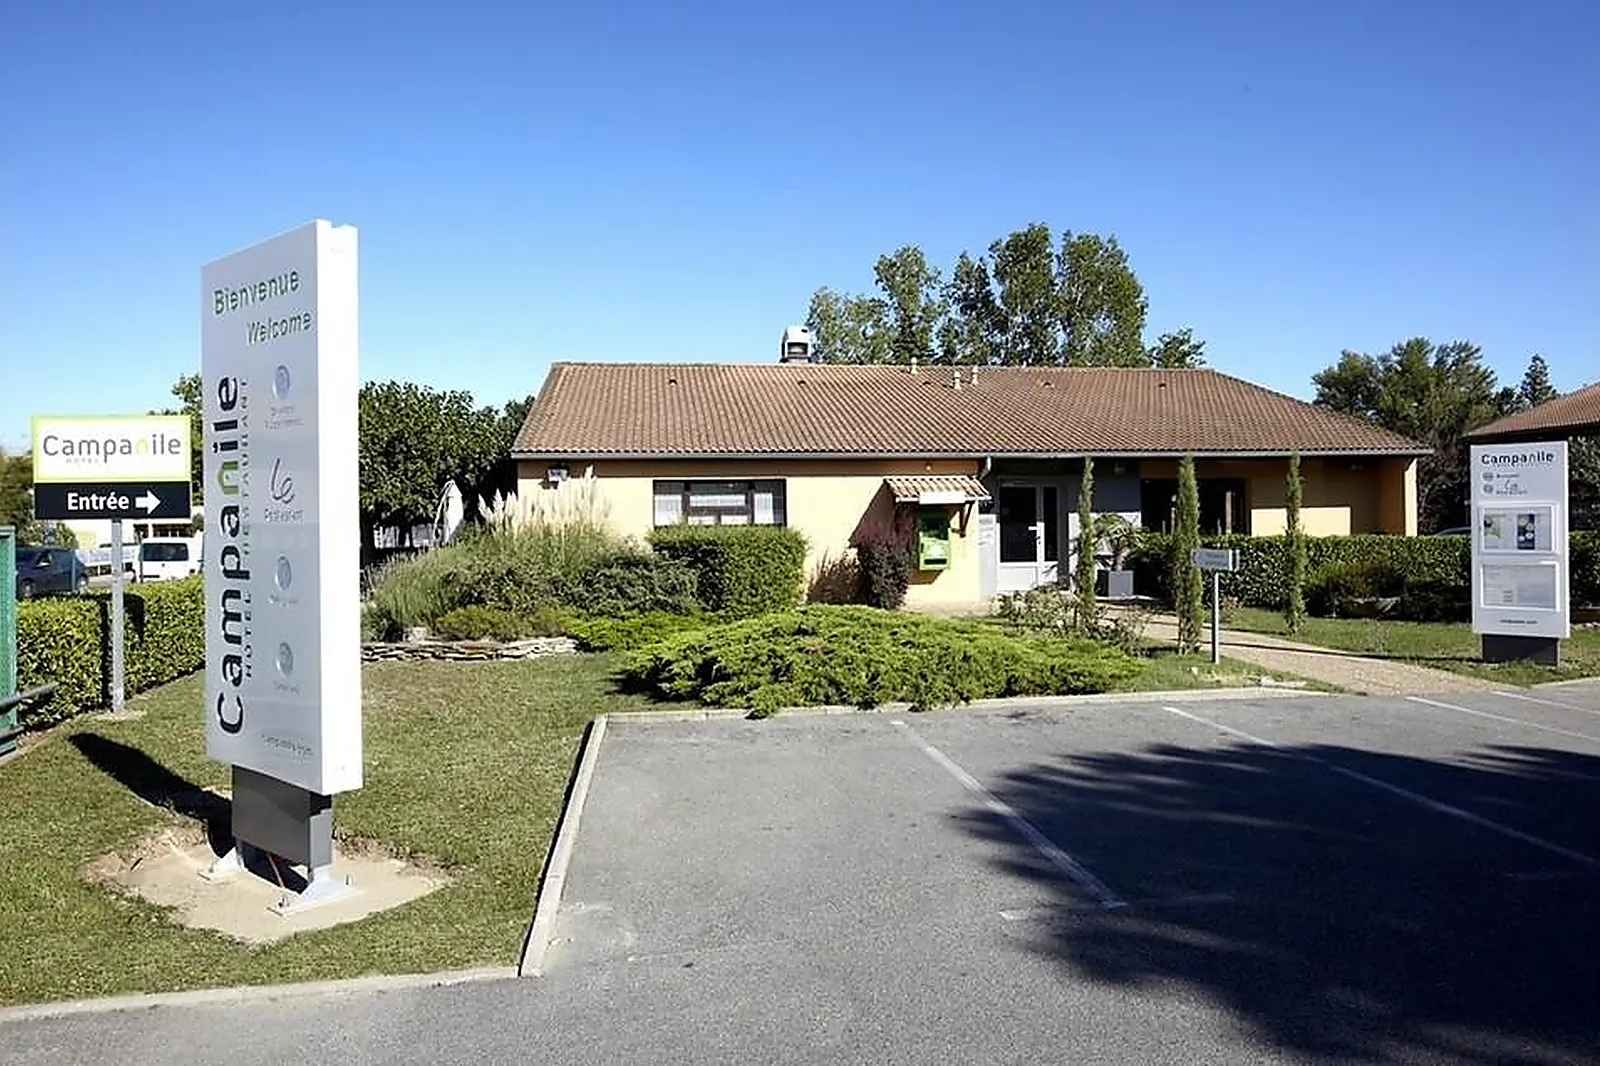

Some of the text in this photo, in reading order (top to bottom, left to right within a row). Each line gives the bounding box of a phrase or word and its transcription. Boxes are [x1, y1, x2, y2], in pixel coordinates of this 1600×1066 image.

[213, 269, 301, 315] Bienvenue
[247, 312, 312, 344] Welcome
[42, 433, 182, 464] Campanile
[1481, 450, 1554, 467] Campanile
[67, 489, 130, 511] Entrée
[213, 377, 251, 735] Campanile
